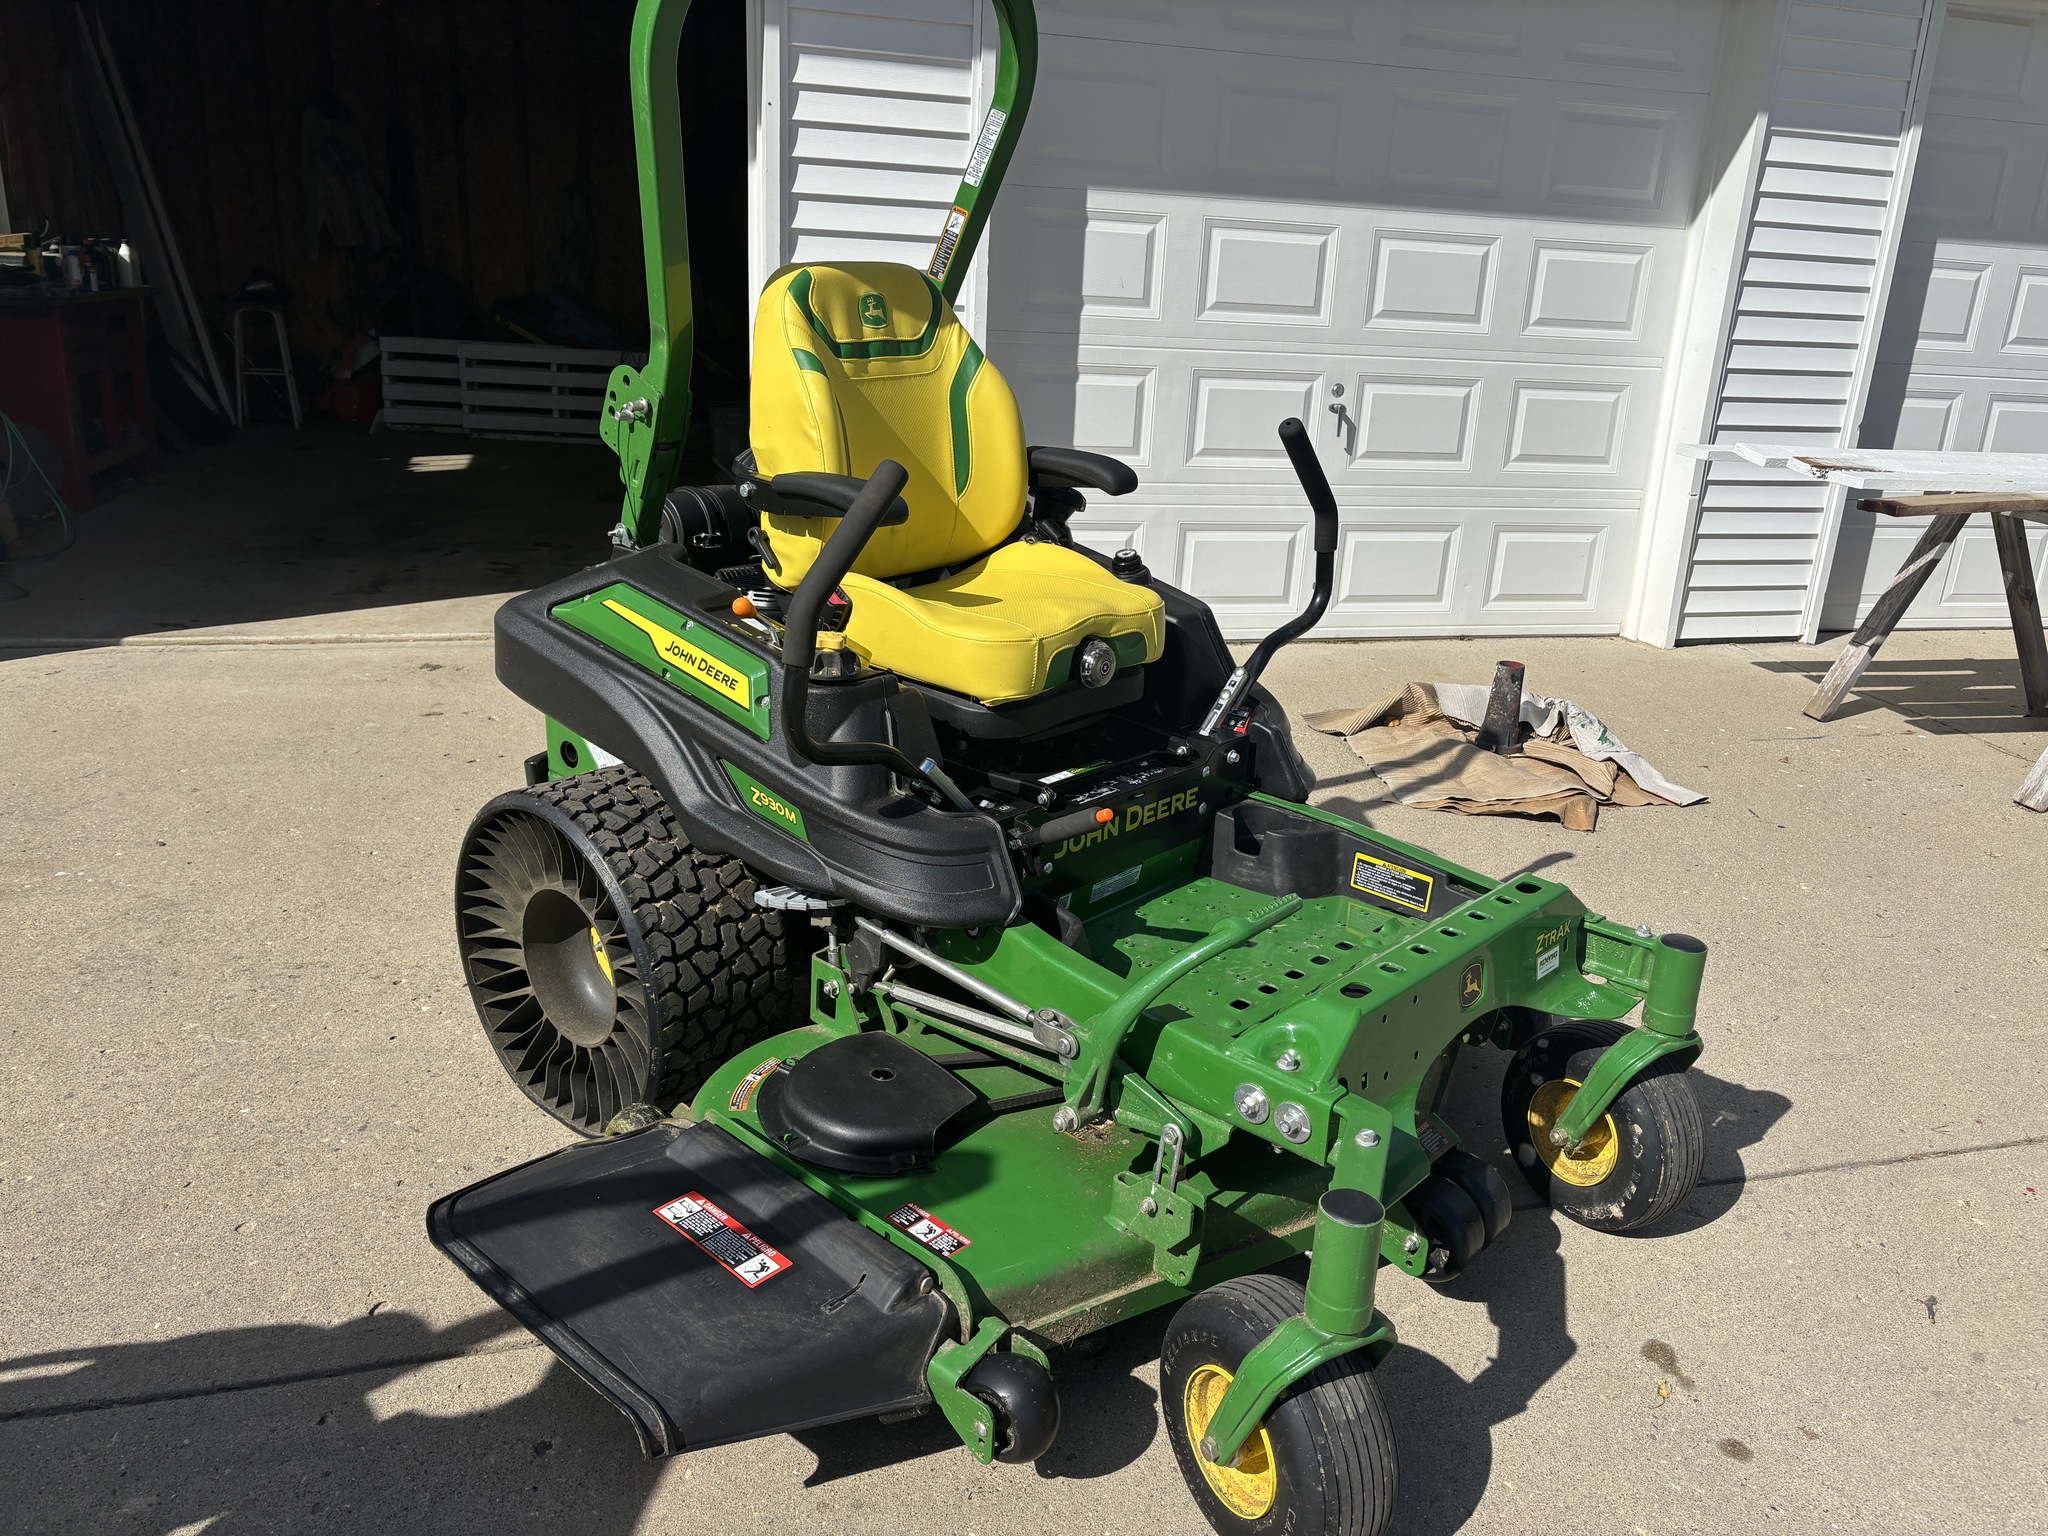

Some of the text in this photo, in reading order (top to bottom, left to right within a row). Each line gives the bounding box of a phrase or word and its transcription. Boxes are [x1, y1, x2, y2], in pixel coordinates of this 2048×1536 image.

[665, 641, 738, 691] JOHN DEERE
[750, 786, 796, 824] Z930M
[1054, 816, 1120, 859] JOHN
[1126, 787, 1199, 832] DEERE
[1536, 919, 1571, 955] ZTRAK
[703, 1201, 728, 1221] DANGER
[912, 1204, 931, 1219] DANGER
[749, 1236, 777, 1257] PELIGRO
